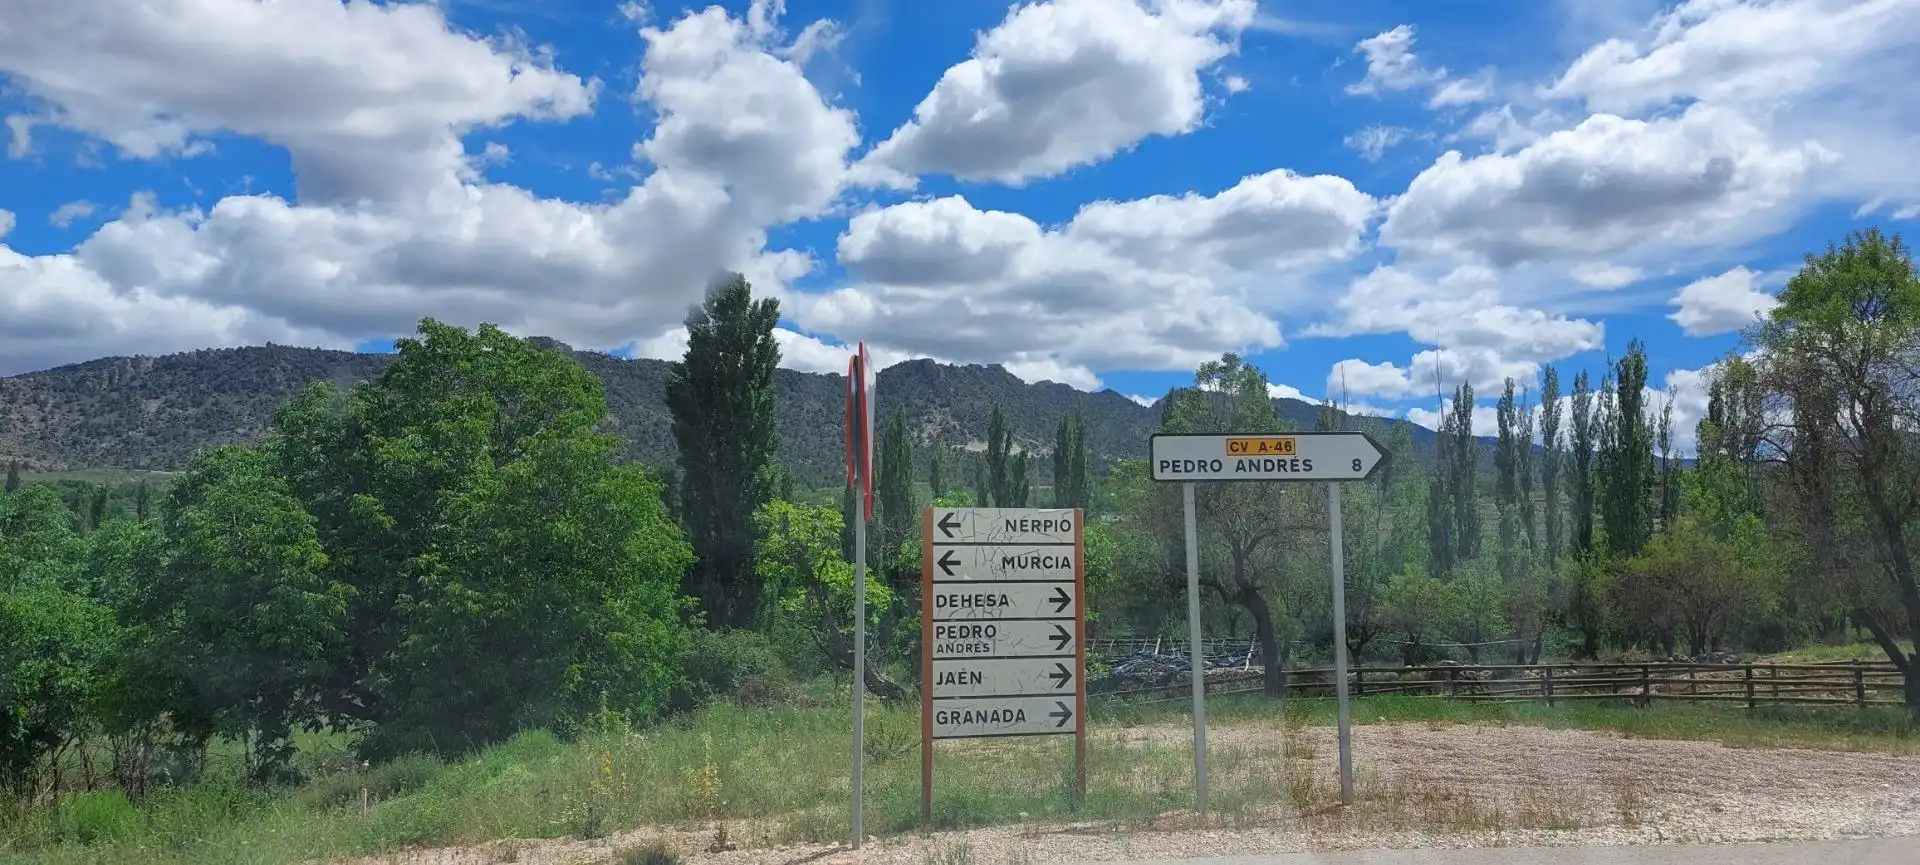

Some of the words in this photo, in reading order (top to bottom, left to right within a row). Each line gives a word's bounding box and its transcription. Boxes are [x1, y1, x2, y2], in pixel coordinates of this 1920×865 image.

[1229, 441, 1249, 453] CV
[1258, 440, 1293, 453] A-46
[1159, 459, 1223, 474] PEDRO
[1235, 456, 1313, 473] ANDRÉS
[1351, 458, 1362, 472] 8
[1005, 519, 1072, 533] NERPIO
[1002, 556, 1072, 569] MURCIA
[936, 594, 1009, 608] DEHESA
[936, 624, 997, 639] PEDRO
[936, 668, 982, 686] JAÉN
[936, 709, 1026, 725] GRANADA
